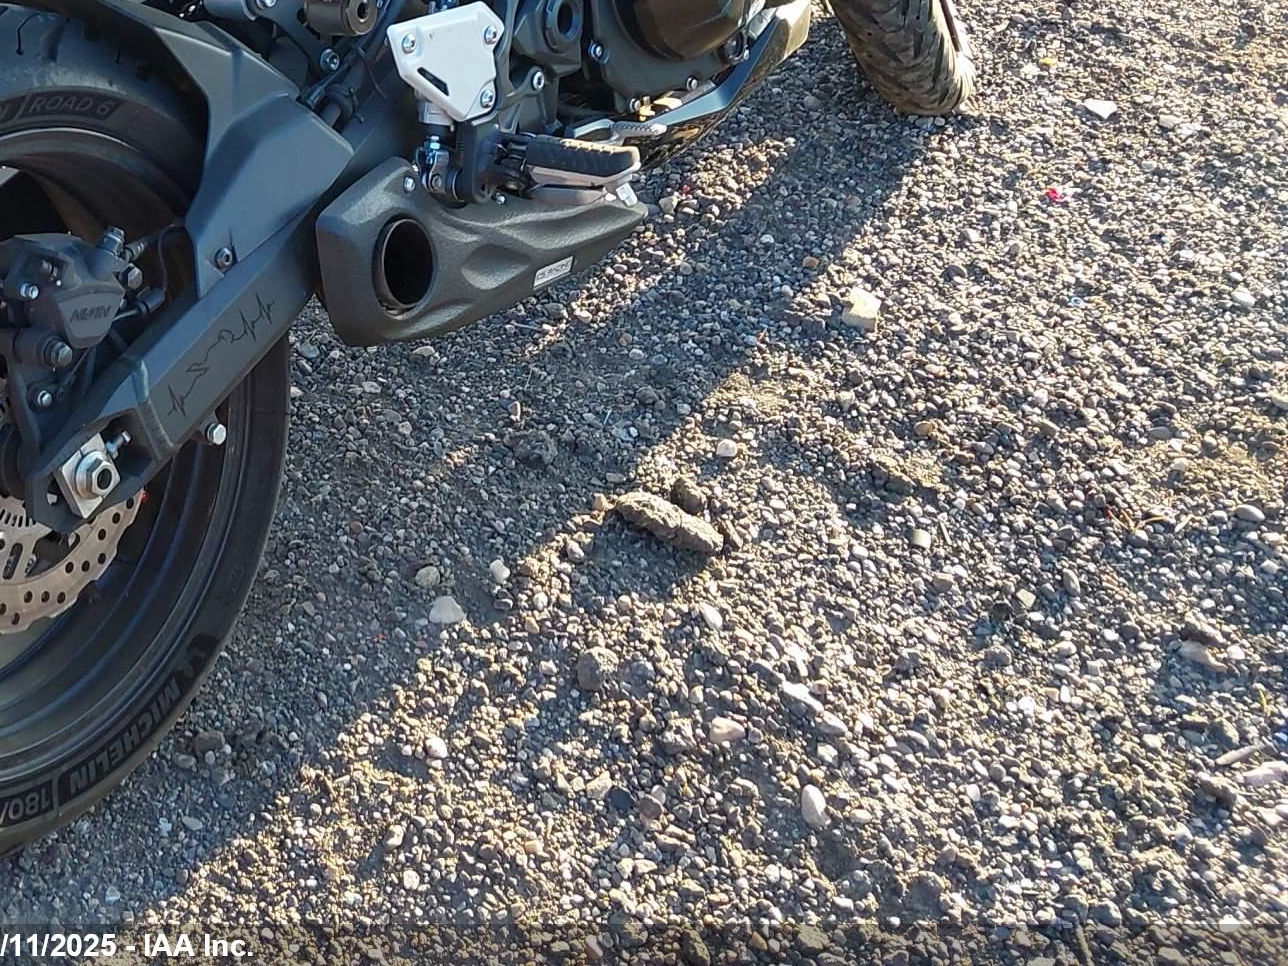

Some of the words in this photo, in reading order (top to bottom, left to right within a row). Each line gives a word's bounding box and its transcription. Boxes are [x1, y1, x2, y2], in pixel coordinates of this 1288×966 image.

[29, 96, 94, 114] ROAD
[96, 100, 114, 116] 6
[70, 677, 182, 794] MICHELIN
